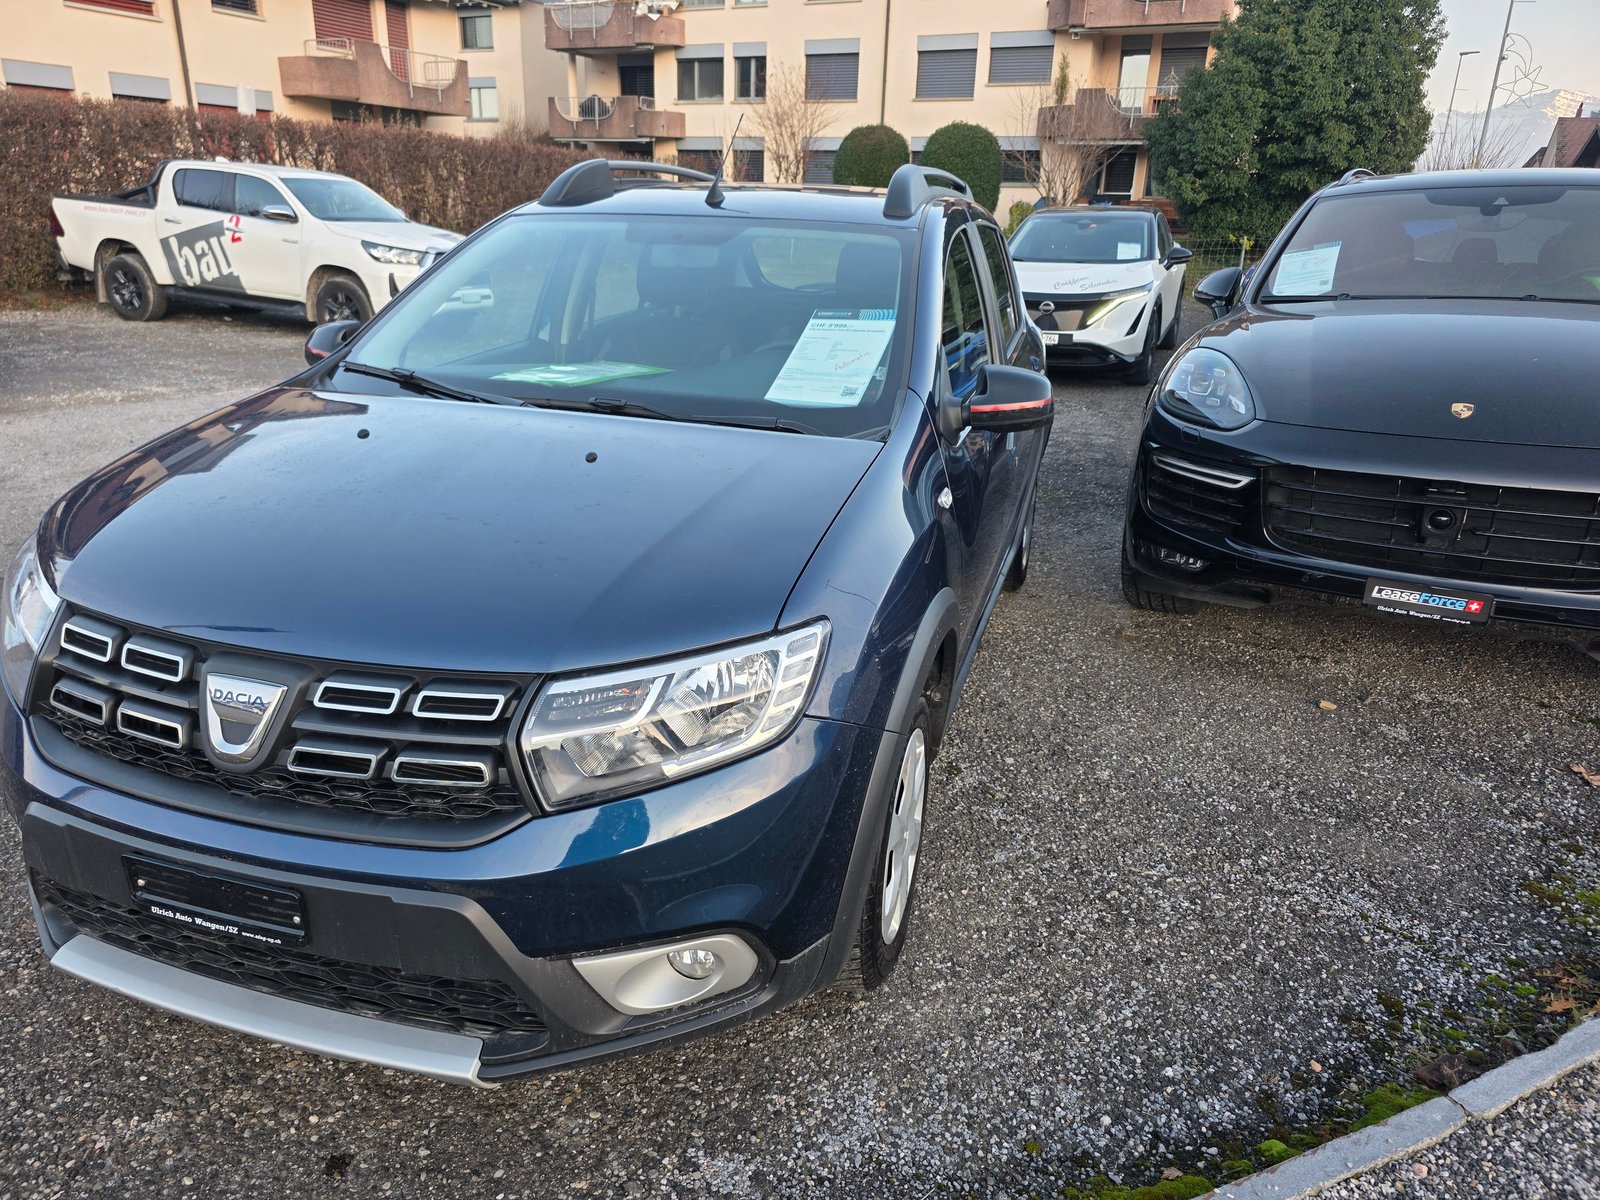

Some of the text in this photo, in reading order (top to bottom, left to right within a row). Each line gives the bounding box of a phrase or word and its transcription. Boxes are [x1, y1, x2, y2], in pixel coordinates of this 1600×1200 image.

[168, 235, 240, 287] bau
[1371, 585, 1467, 610] LeaseForce
[1377, 605, 1394, 613] Ulrich
[1409, 610, 1441, 620] Wangen/SZ
[213, 688, 265, 708] DACIA
[151, 905, 174, 918] Ulrich
[175, 912, 192, 923] Auto
[194, 917, 239, 934] Wangen/SZ
